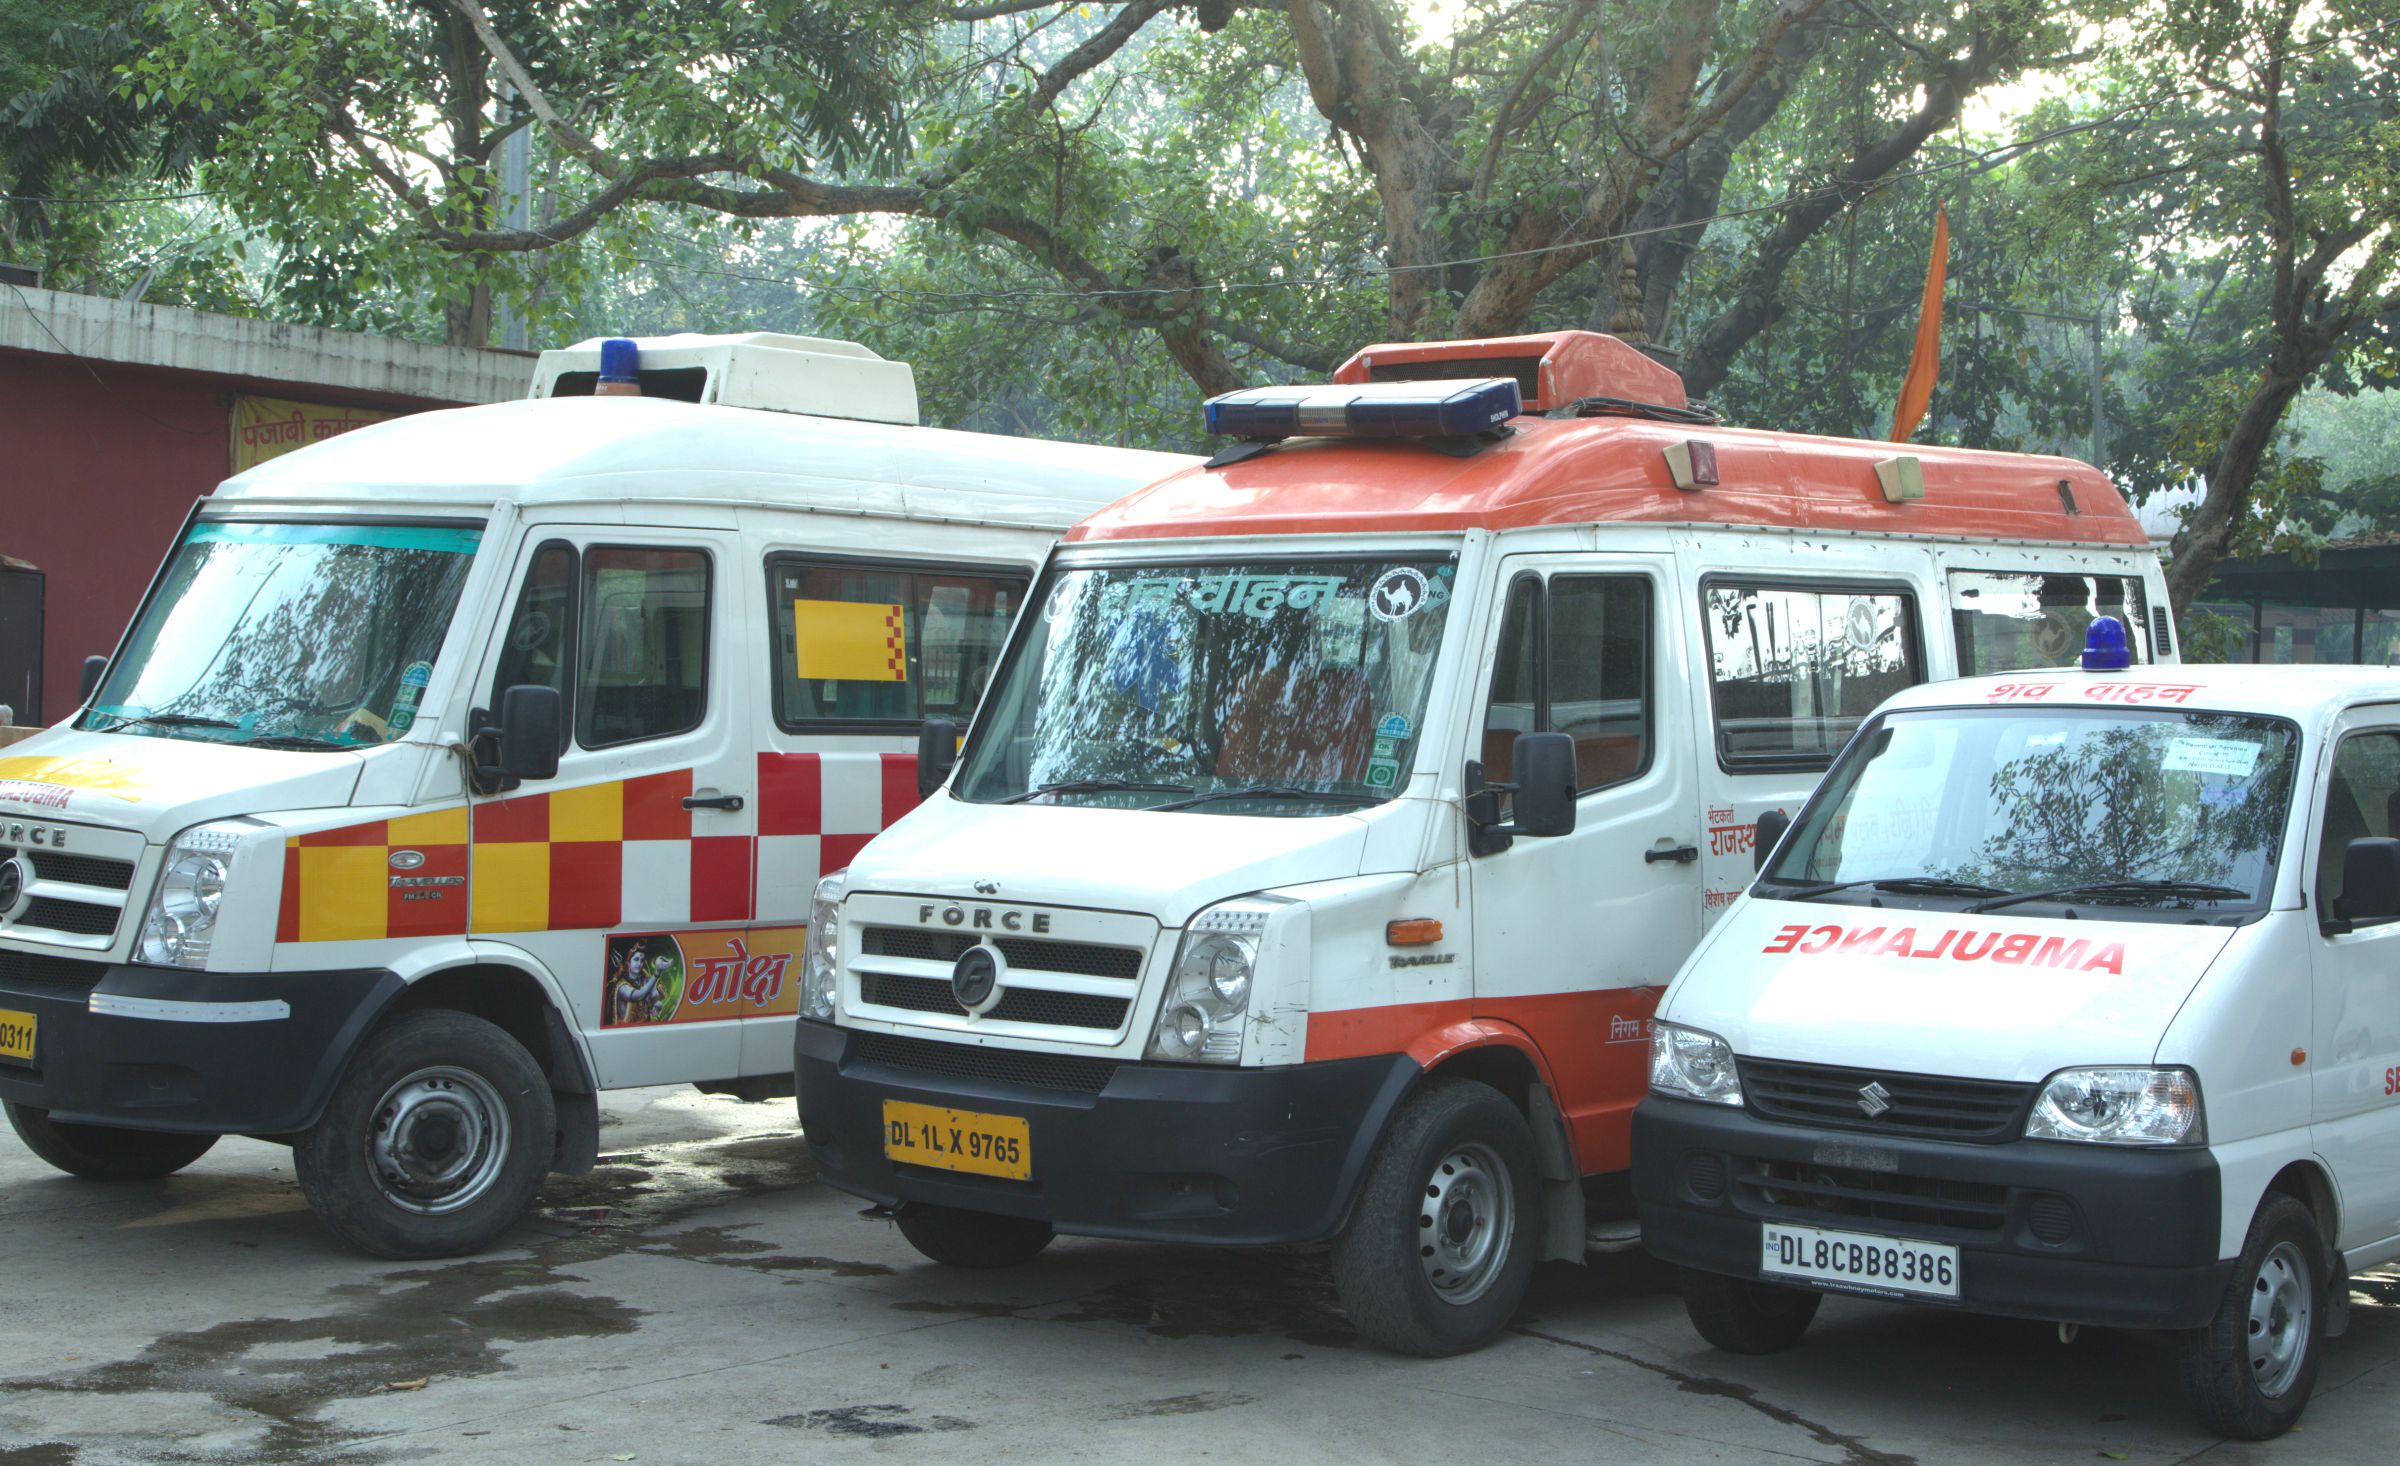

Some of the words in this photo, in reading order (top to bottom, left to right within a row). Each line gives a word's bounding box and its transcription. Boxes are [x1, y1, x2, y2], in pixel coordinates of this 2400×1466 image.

[240, 409, 307, 448] पंजाबी
[1190, 574, 1348, 618] वाहन
[1985, 682, 2066, 705] शव
[2084, 682, 2209, 704] वाहन
[919, 903, 1050, 933] FORCE
[688, 937, 793, 1008] मोक्ष
[0, 1022, 33, 1052] 0311
[1611, 1015, 1640, 1040] निगम
[891, 1120, 915, 1148] DL
[921, 1123, 944, 1152] 1L
[949, 1127, 964, 1156] X
[968, 1131, 1020, 1164] 9765
[1765, 1242, 1780, 1252] IND
[1780, 1234, 1953, 1286] DL8CBB8386
